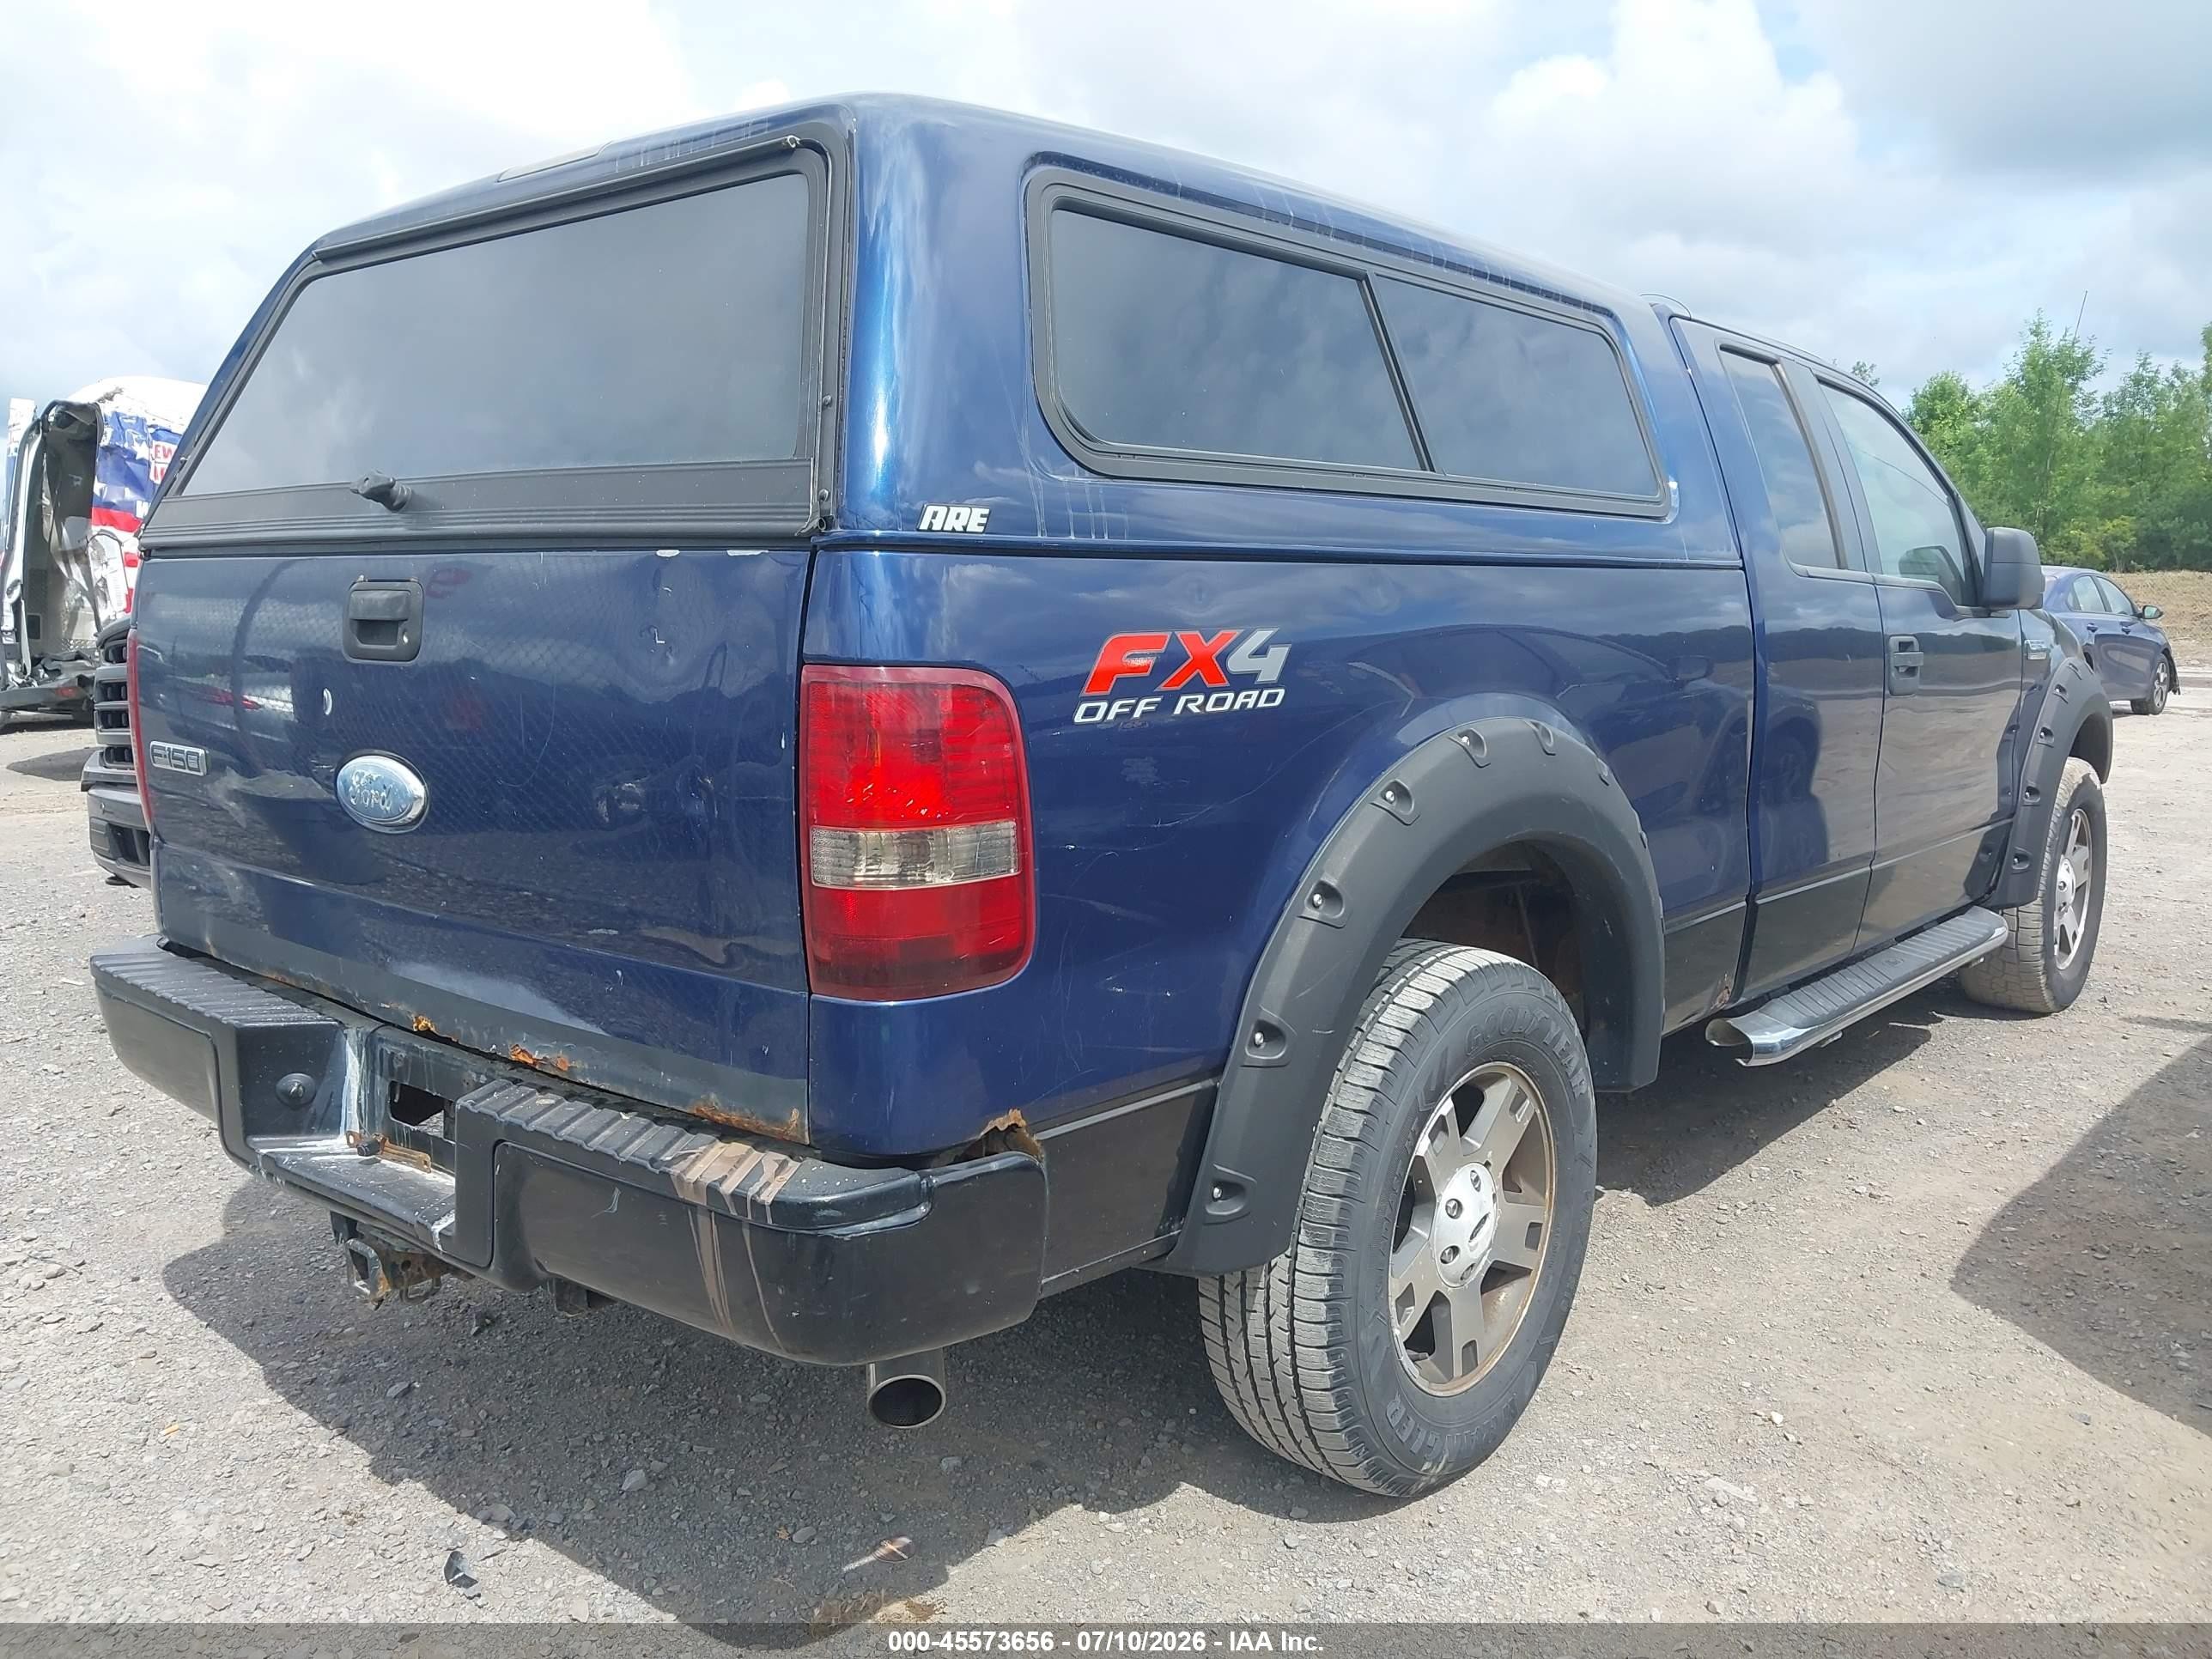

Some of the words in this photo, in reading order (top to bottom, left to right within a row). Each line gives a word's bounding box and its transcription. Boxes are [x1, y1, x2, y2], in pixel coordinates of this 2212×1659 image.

[919, 505, 990, 532] ARE
[1081, 628, 1291, 696] FX4
[1073, 696, 1164, 724] OFF
[1173, 688, 1286, 716] ROAD
[1466, 1005, 1588, 1099] GOODYEAR
